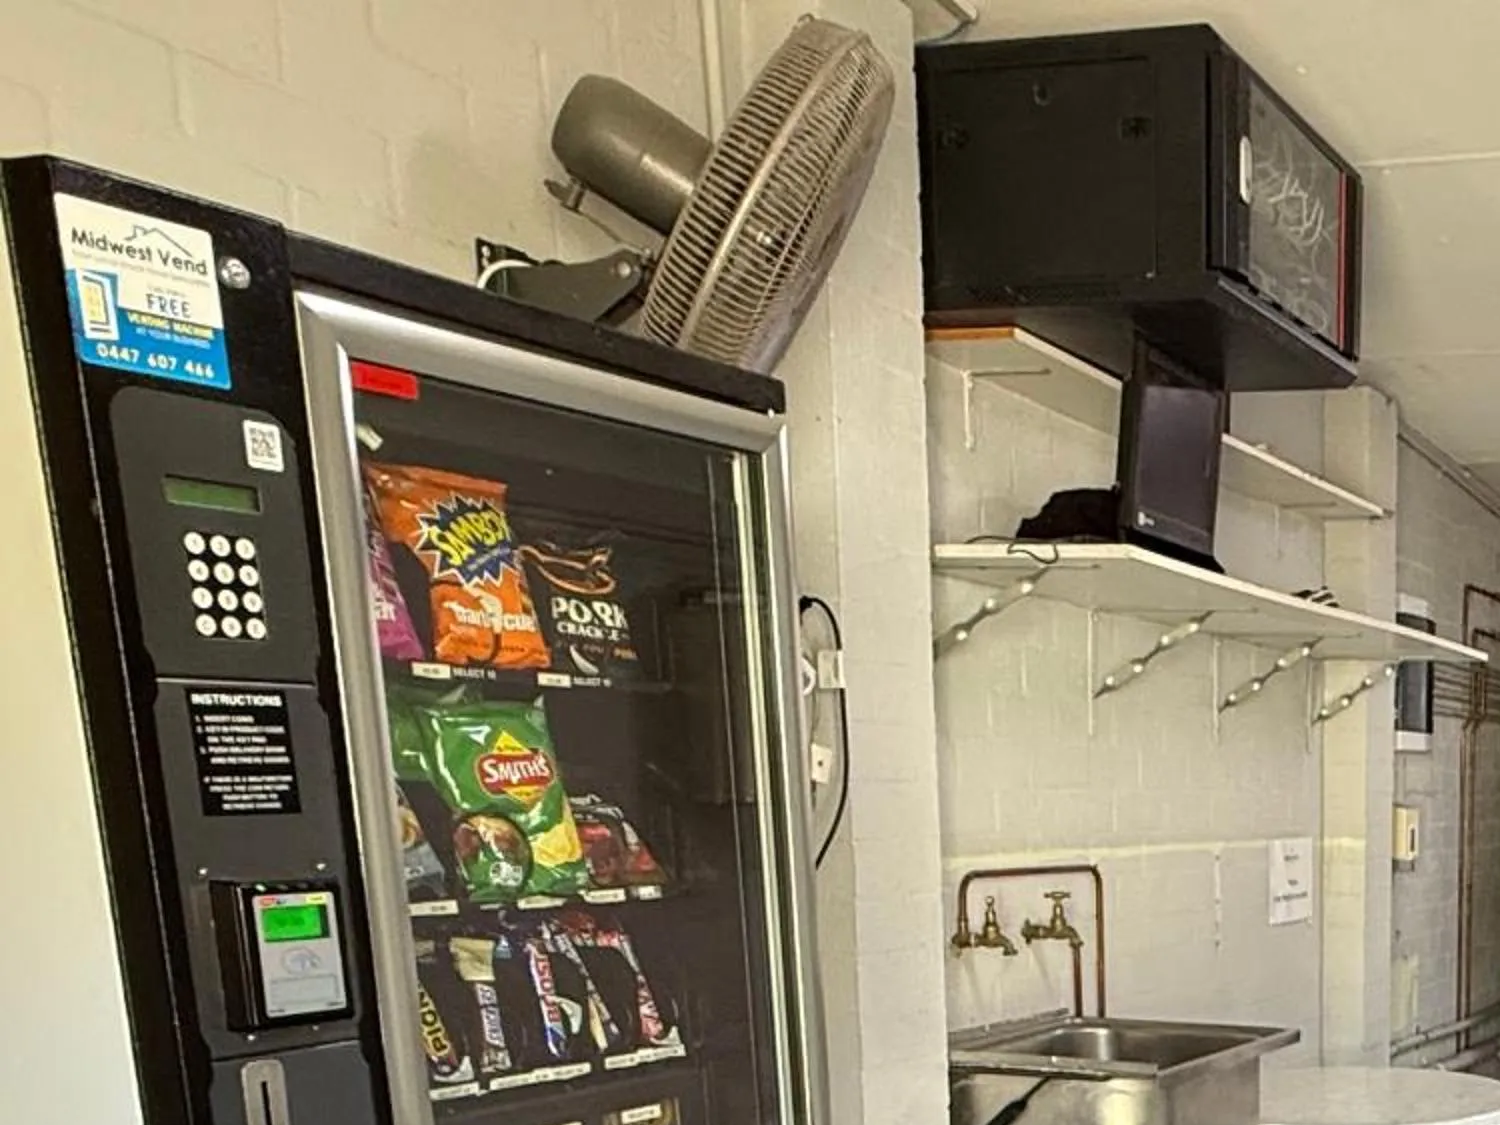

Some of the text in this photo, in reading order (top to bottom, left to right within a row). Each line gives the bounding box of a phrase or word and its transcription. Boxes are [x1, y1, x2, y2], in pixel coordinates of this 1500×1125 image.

[71, 227, 152, 262] Midwest
[157, 249, 208, 276] Vend
[146, 293, 191, 319] FREE
[95, 342, 140, 363] 0447
[552, 596, 628, 630] PORK
[191, 693, 283, 707] INSTRUCTIONS
